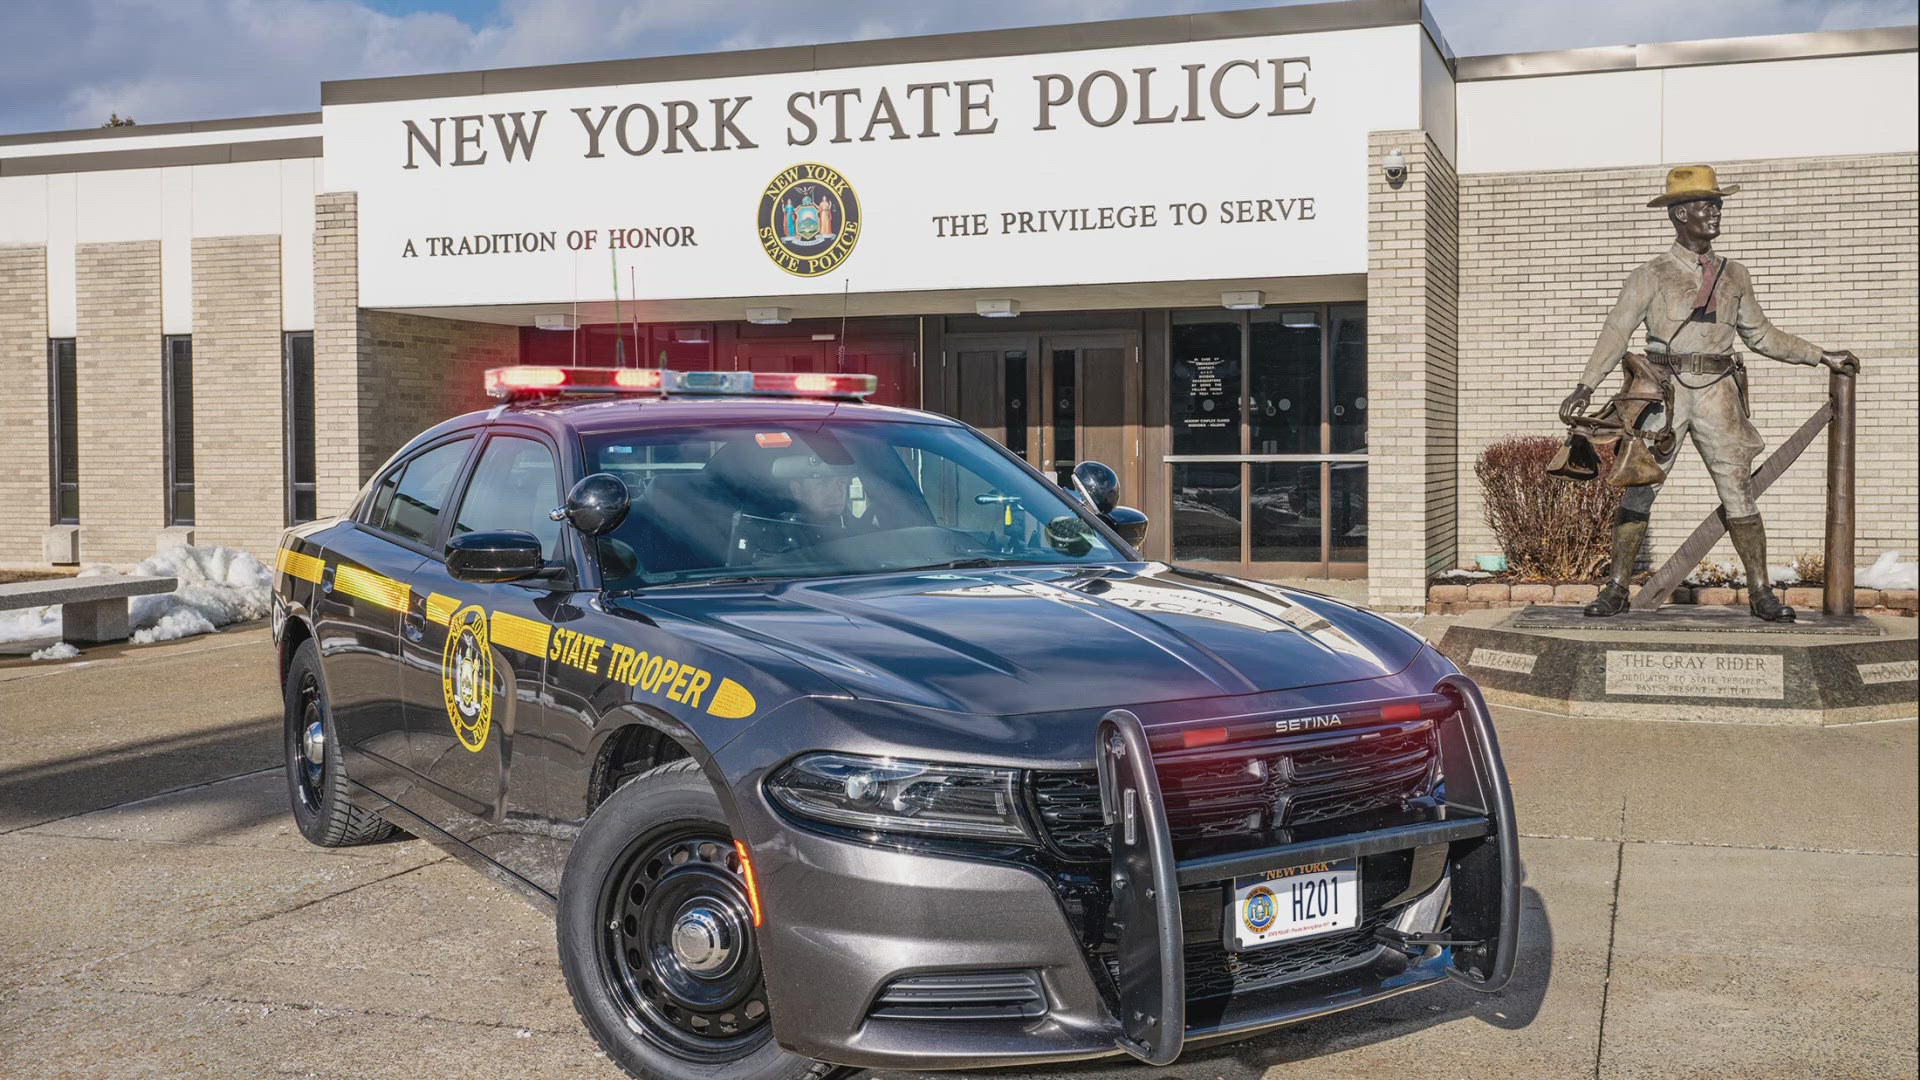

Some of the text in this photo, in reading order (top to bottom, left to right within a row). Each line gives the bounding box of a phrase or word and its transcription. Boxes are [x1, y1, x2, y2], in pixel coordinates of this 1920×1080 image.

[402, 56, 1316, 169] NEW YORK STATE POLICE
[766, 165, 850, 201] NEW YORK
[932, 197, 1317, 238] THE PRIVILEGE TO SERVE
[402, 226, 699, 258] A TRADITION OF HONOR
[760, 221, 858, 274] STATE POLICE
[549, 627, 712, 709] STATE TROOPER
[1620, 673, 1768, 685] DEDICATED TO STATE TROOPERS
[1622, 654, 1766, 672] THE GRAY RIDER
[1275, 714, 1342, 733] SETINA
[1266, 861, 1329, 881] NEW YORK
[1292, 876, 1338, 922] H201
